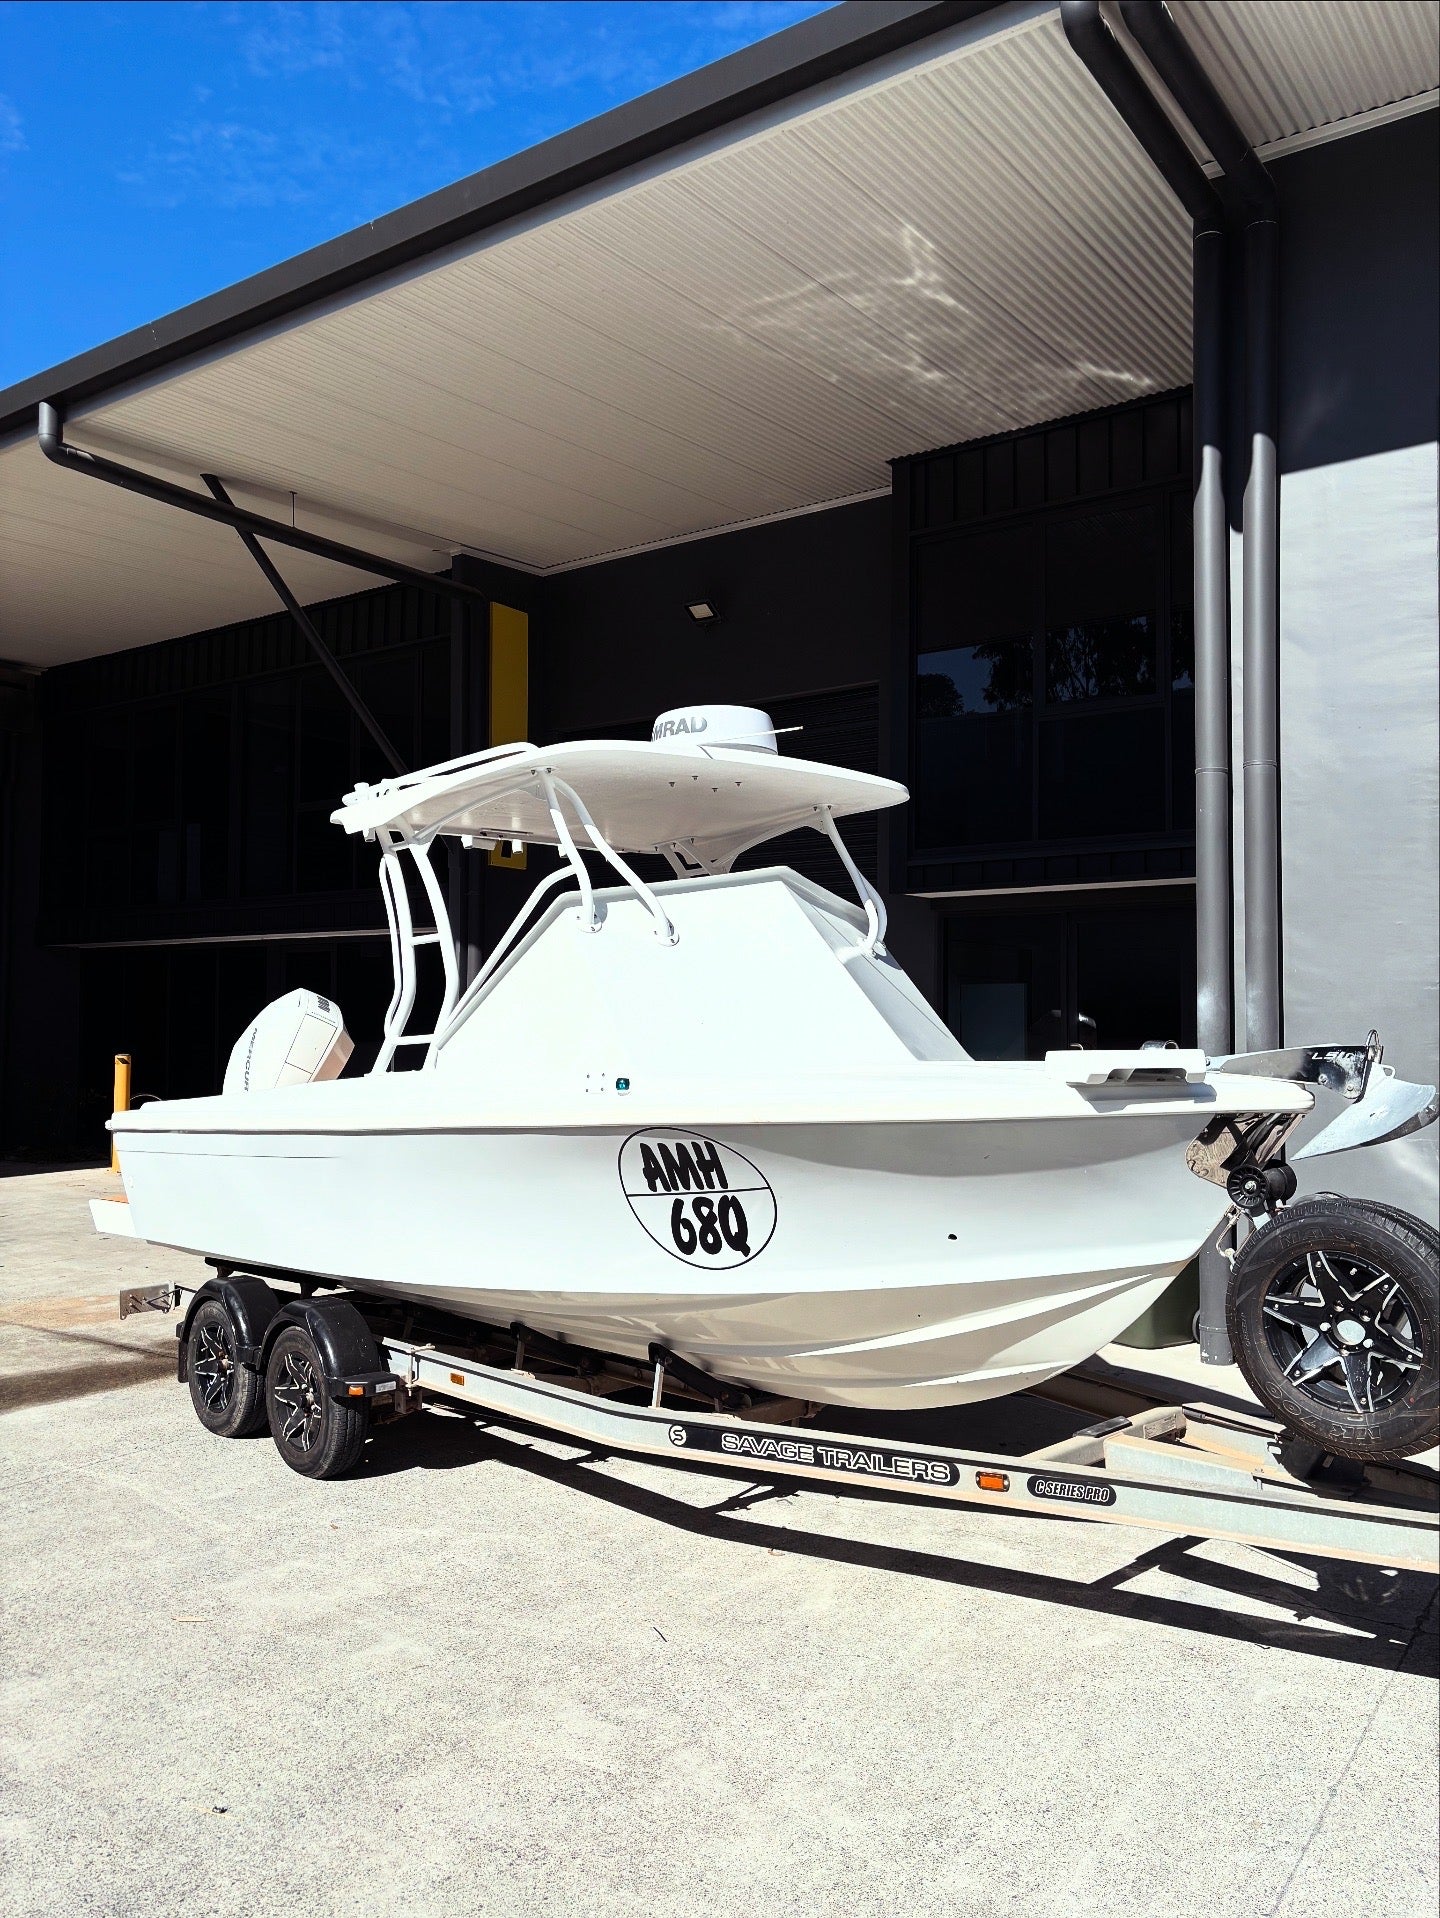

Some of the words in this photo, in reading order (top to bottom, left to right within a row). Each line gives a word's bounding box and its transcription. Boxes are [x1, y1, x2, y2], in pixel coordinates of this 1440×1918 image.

[640, 1141, 729, 1193] AMH
[671, 1194, 751, 1258] 68Q
[721, 1433, 815, 1464] SAVAGE
[816, 1446, 950, 1483] TRAILERS
[1035, 1479, 1045, 1494] C
[1045, 1480, 1085, 1499] SERIES
[1085, 1486, 1110, 1502] PRO
